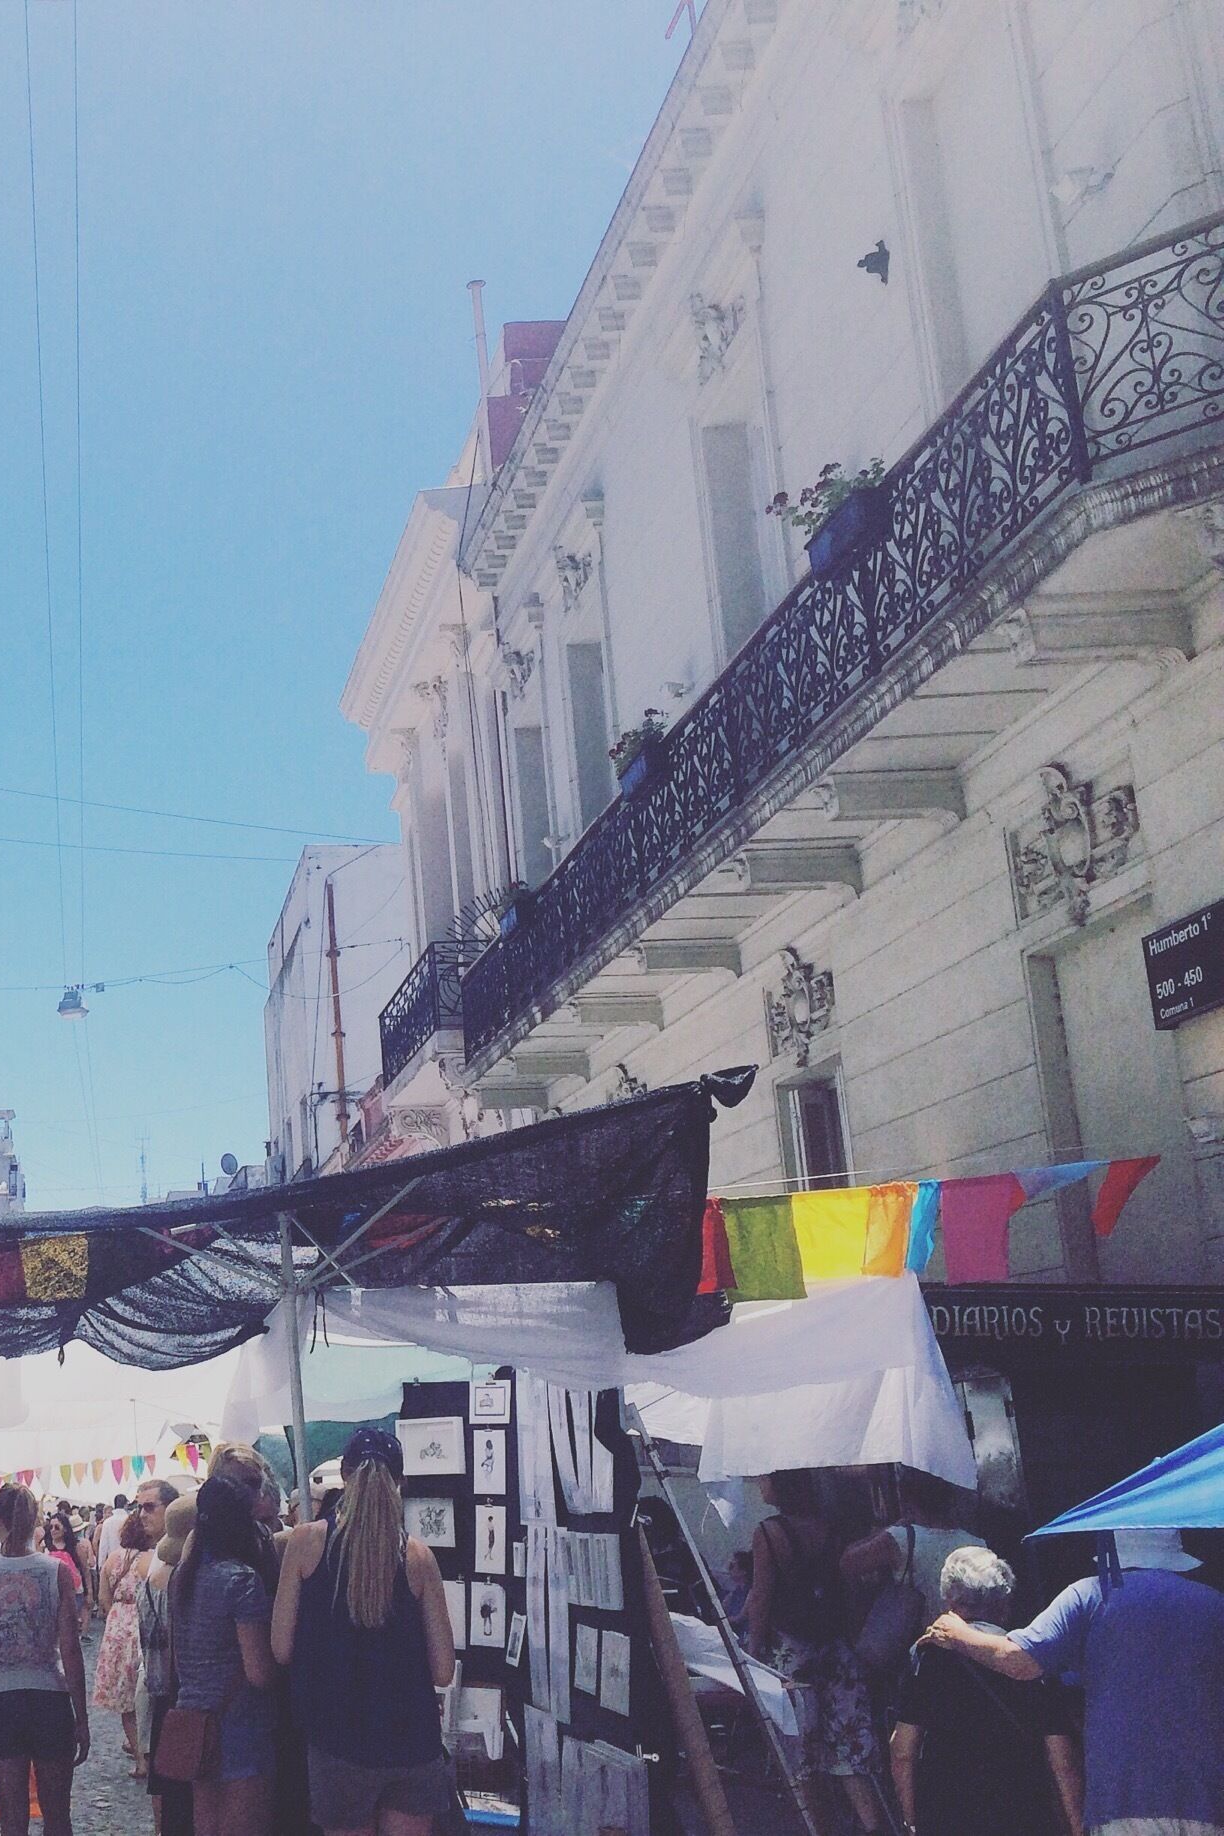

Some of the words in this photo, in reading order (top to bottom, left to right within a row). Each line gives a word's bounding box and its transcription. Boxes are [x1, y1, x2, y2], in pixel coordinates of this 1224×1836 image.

[1148, 923, 1200, 956] Humberto
[1156, 978, 1175, 999] 500
[1183, 966, 1203, 987] 450
[1160, 1000, 1189, 1019] Comuna
[1189, 997, 1194, 1007] 1
[930, 1305, 1043, 1341] DIARIOS
